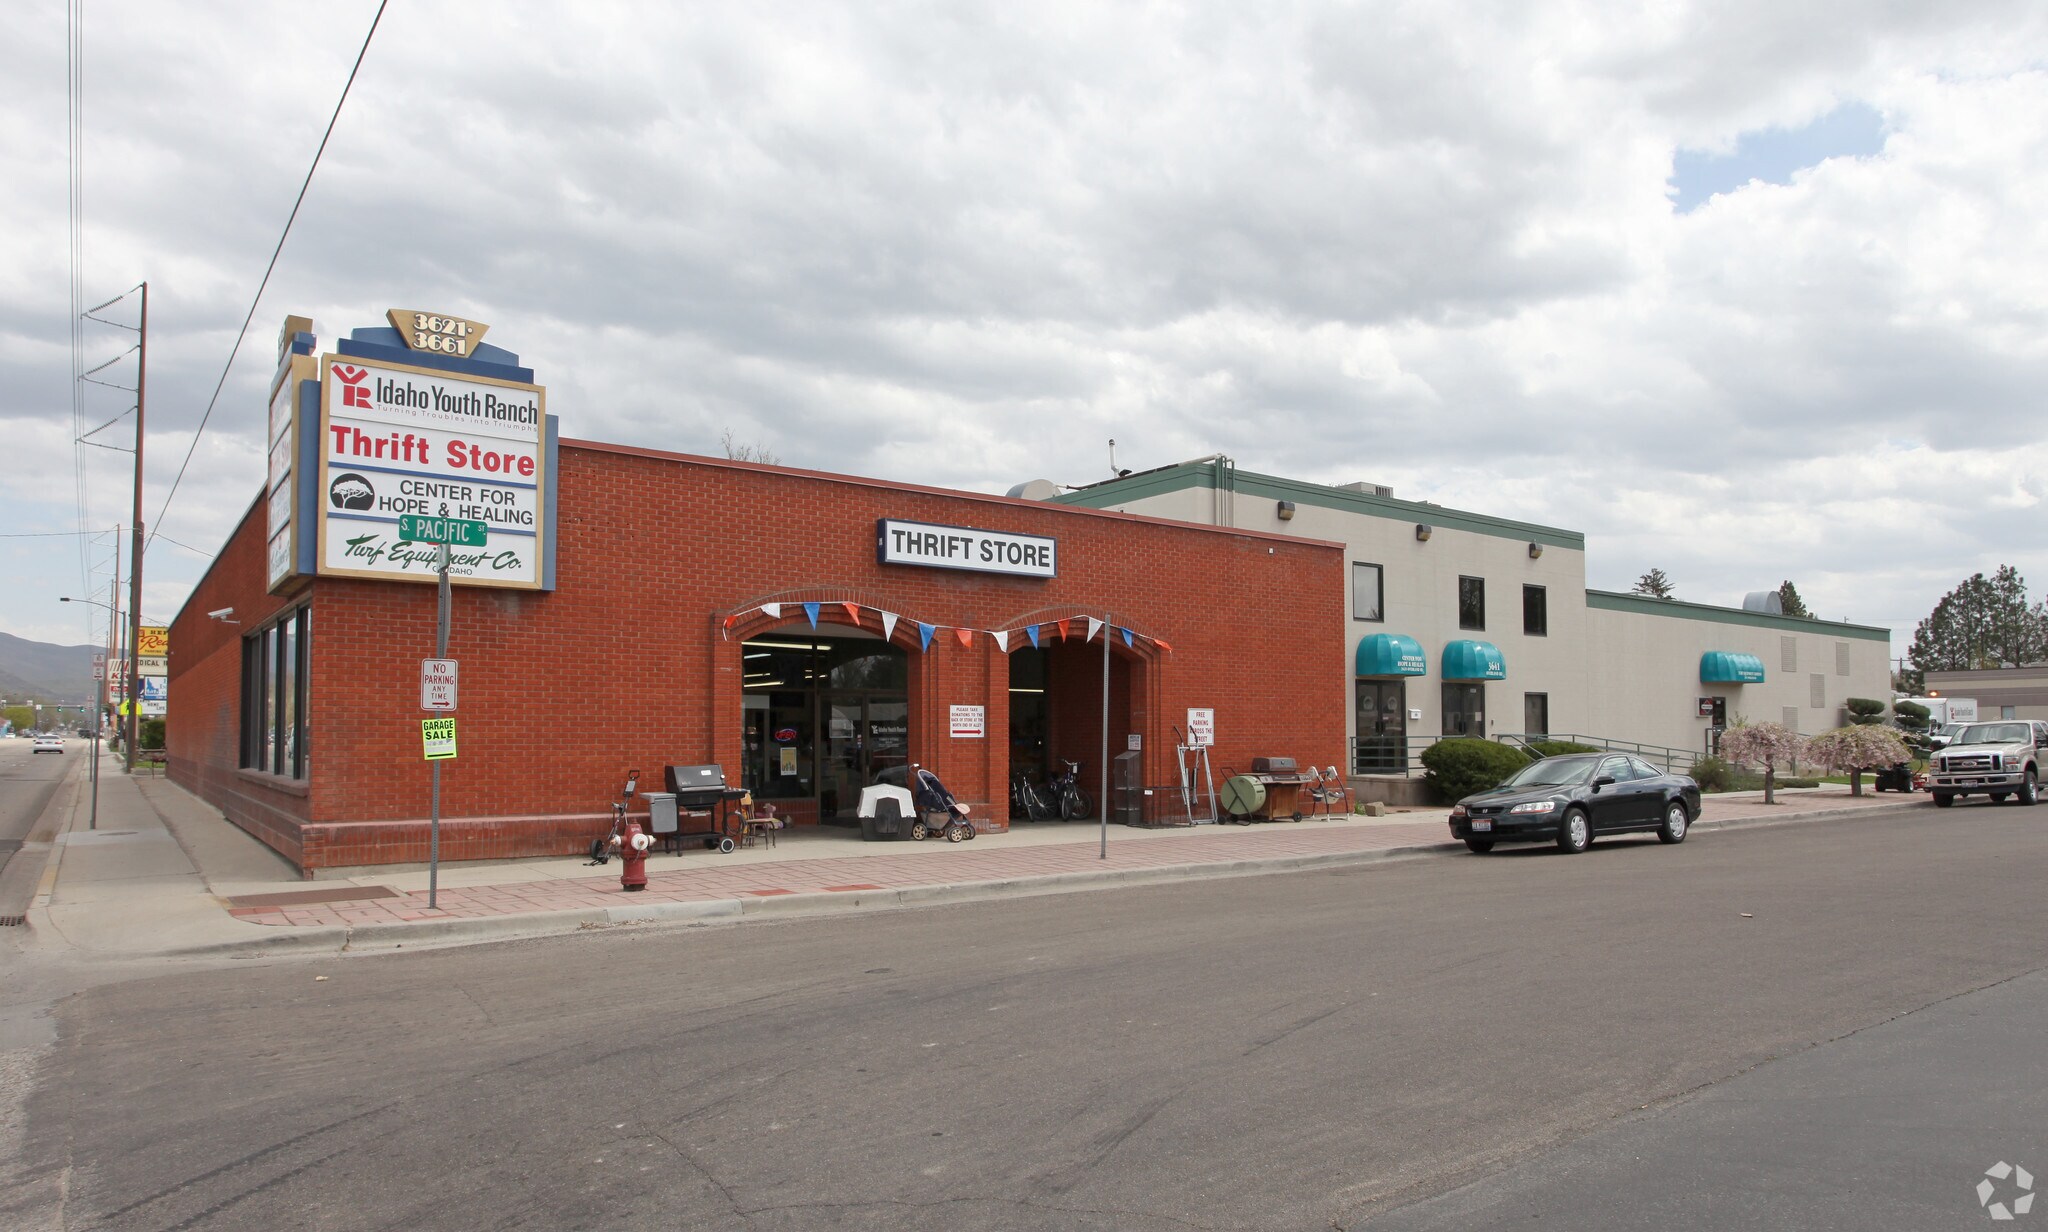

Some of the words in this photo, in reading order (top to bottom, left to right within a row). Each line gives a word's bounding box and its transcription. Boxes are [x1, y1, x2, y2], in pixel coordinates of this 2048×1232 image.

[413, 331, 467, 355] 3661
[376, 377, 429, 409] Idaho
[431, 385, 481, 416] Youth
[485, 393, 538, 424] Ranch
[377, 404, 417, 417] Turning
[421, 410, 465, 423] Troubles
[470, 418, 490, 426] into
[493, 420, 538, 432] Triumphs
[330, 424, 430, 464] Thrift
[446, 439, 535, 477] Store
[400, 480, 472, 501] CENTER
[480, 488, 516, 506] FOR
[379, 496, 429, 515] HOPE
[438, 502, 450, 517] &
[459, 504, 533, 525] HEALING
[400, 518, 410, 531] S.
[416, 519, 470, 541] PACIFIC
[345, 533, 388, 565] Turf
[492, 550, 522, 570] Co.
[891, 529, 974, 560] THRIFT
[980, 538, 1050, 567] STORE
[424, 674, 454, 685] PARKING
[433, 664, 446, 674] NO
[423, 720, 454, 731] GARAGE
[425, 729, 453, 740] SALE
